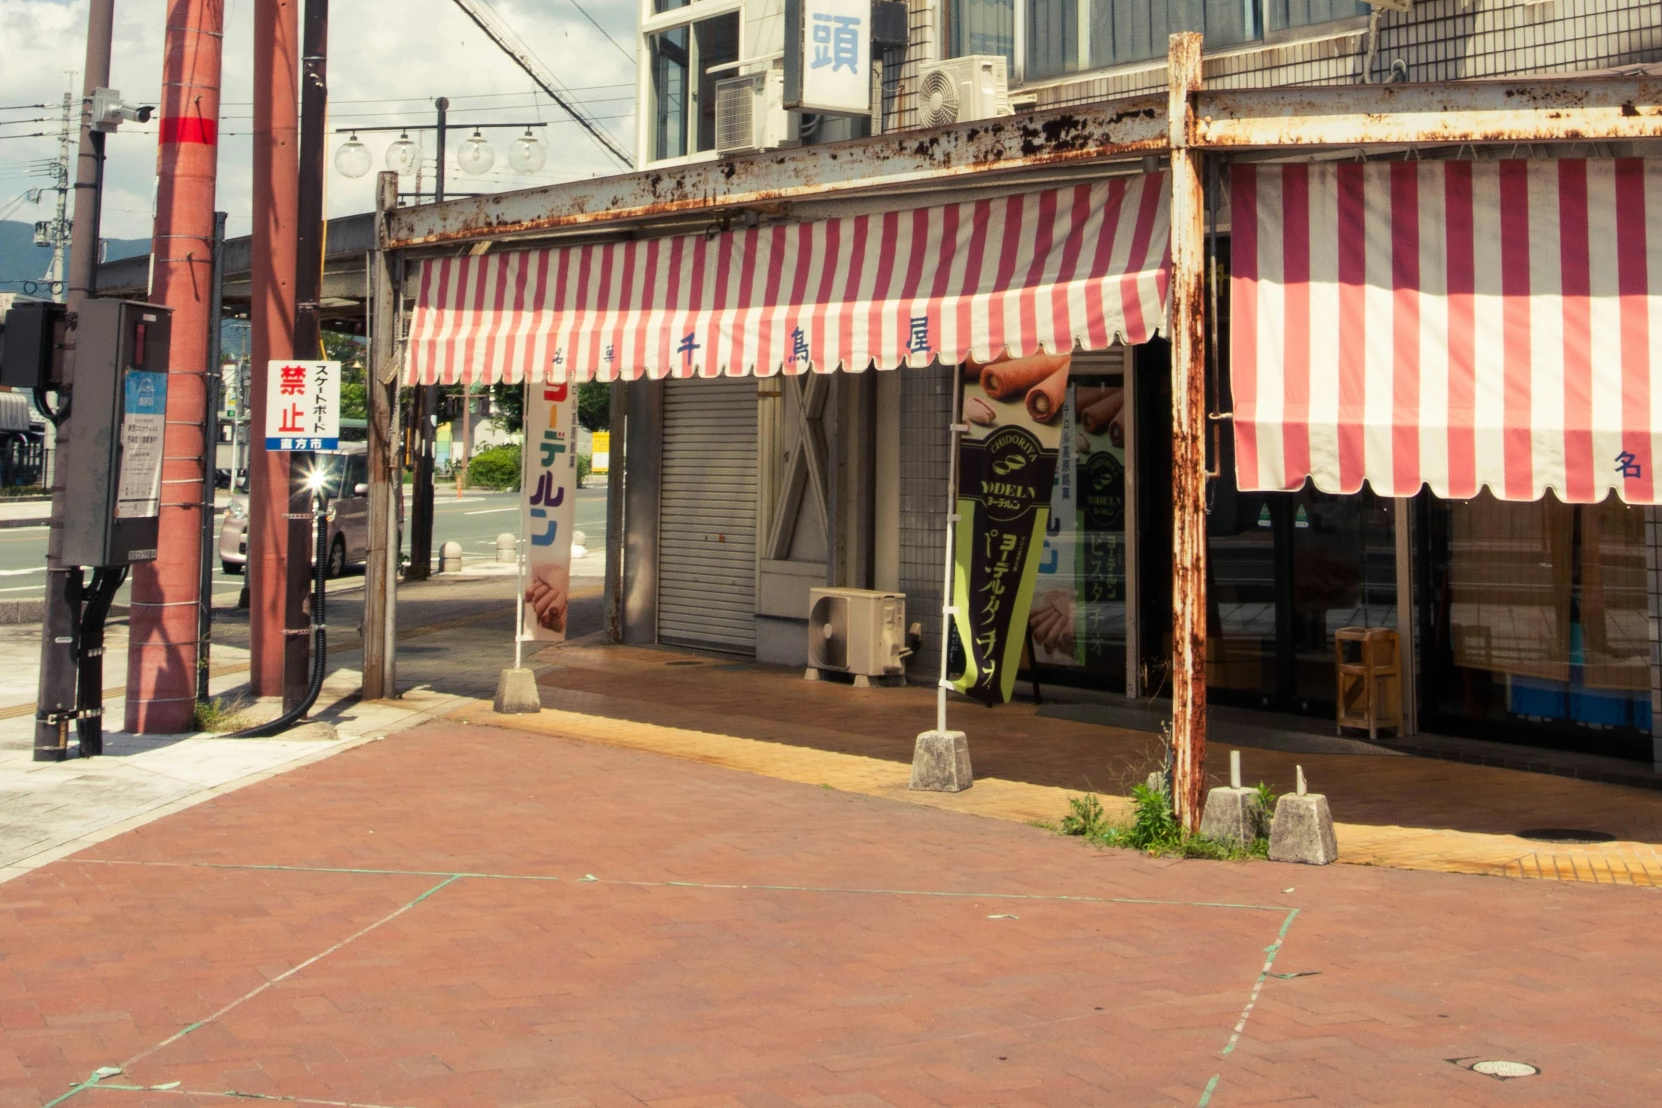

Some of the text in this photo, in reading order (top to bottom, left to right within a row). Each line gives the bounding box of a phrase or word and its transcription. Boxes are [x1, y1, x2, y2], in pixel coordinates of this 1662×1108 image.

[552, 316, 932, 366] 名菓 千鳥屋
[278, 365, 306, 432] 禁止
[314, 365, 328, 433] スケートボード
[281, 438, 322, 450] 直方市
[991, 435, 1037, 462] CHIDORIYA
[1614, 451, 1641, 478] 名
